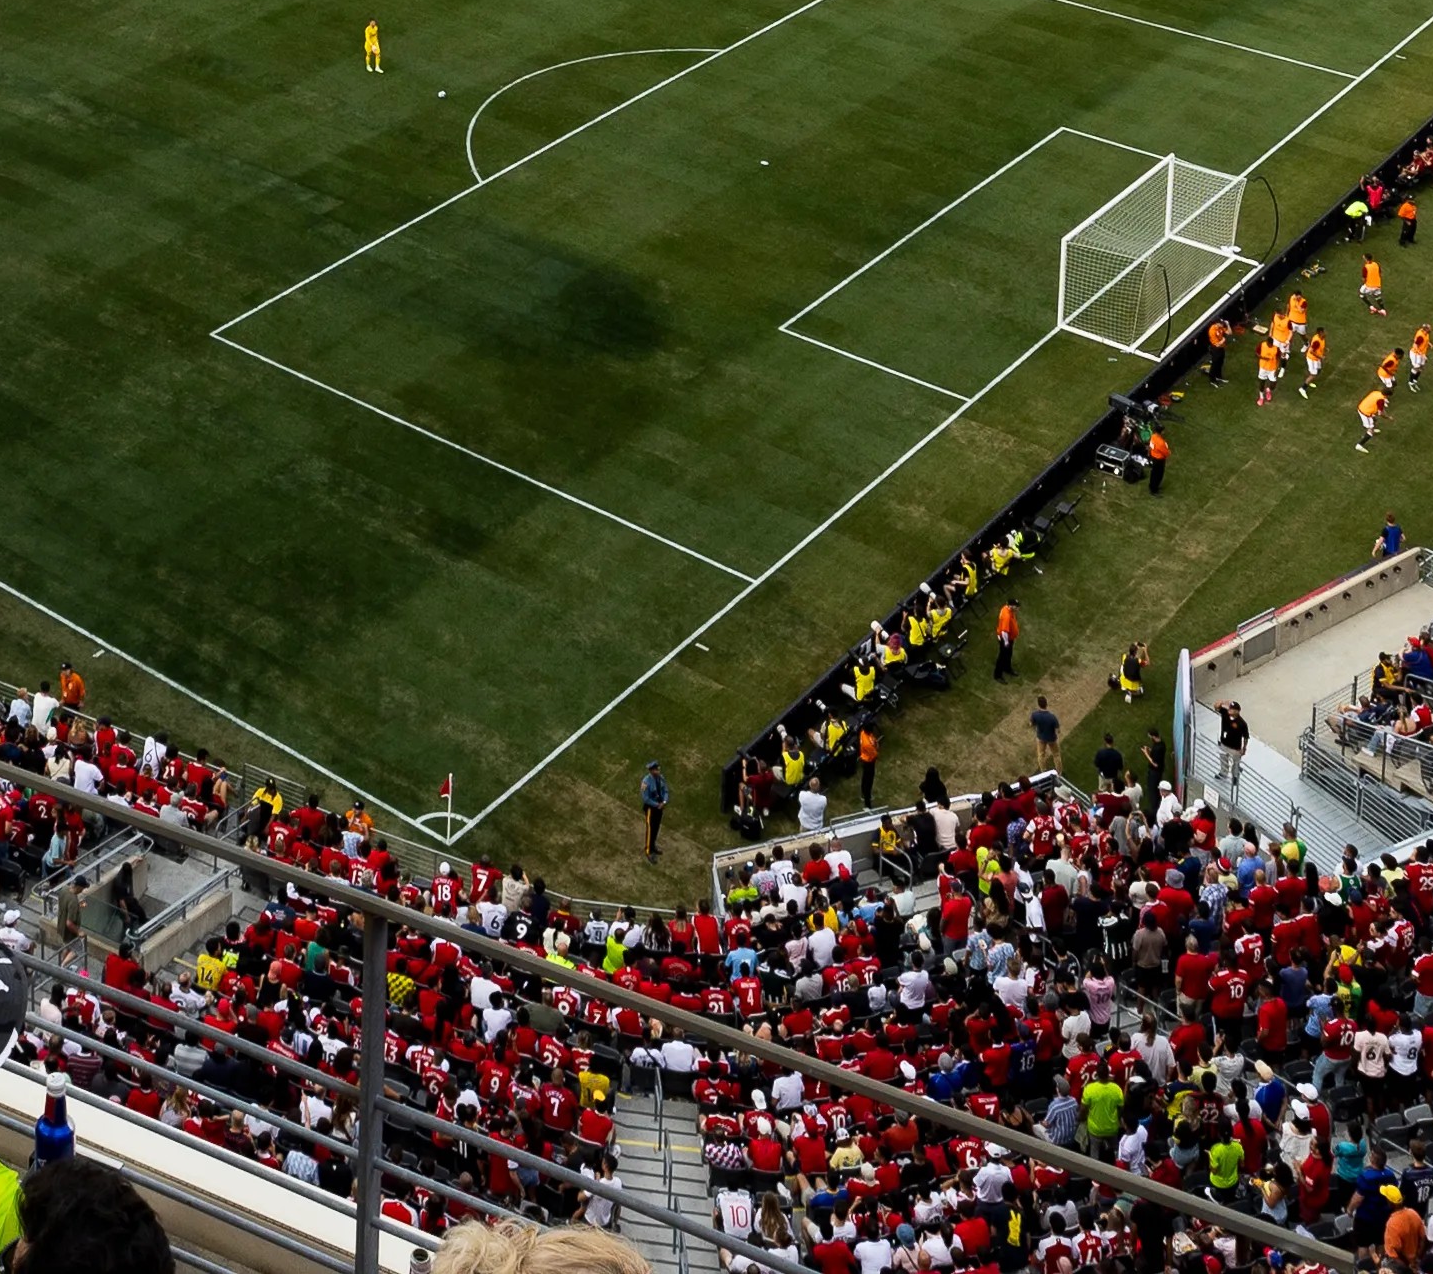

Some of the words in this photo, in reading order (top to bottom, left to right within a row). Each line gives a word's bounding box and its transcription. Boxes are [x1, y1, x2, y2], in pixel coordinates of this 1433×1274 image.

[476, 873, 488, 892] 7
[437, 884, 451, 901] 18
[515, 922, 528, 940] 9
[199, 968, 214, 984] 14
[965, 1150, 977, 1169] 6
[729, 1203, 749, 1228] 10
